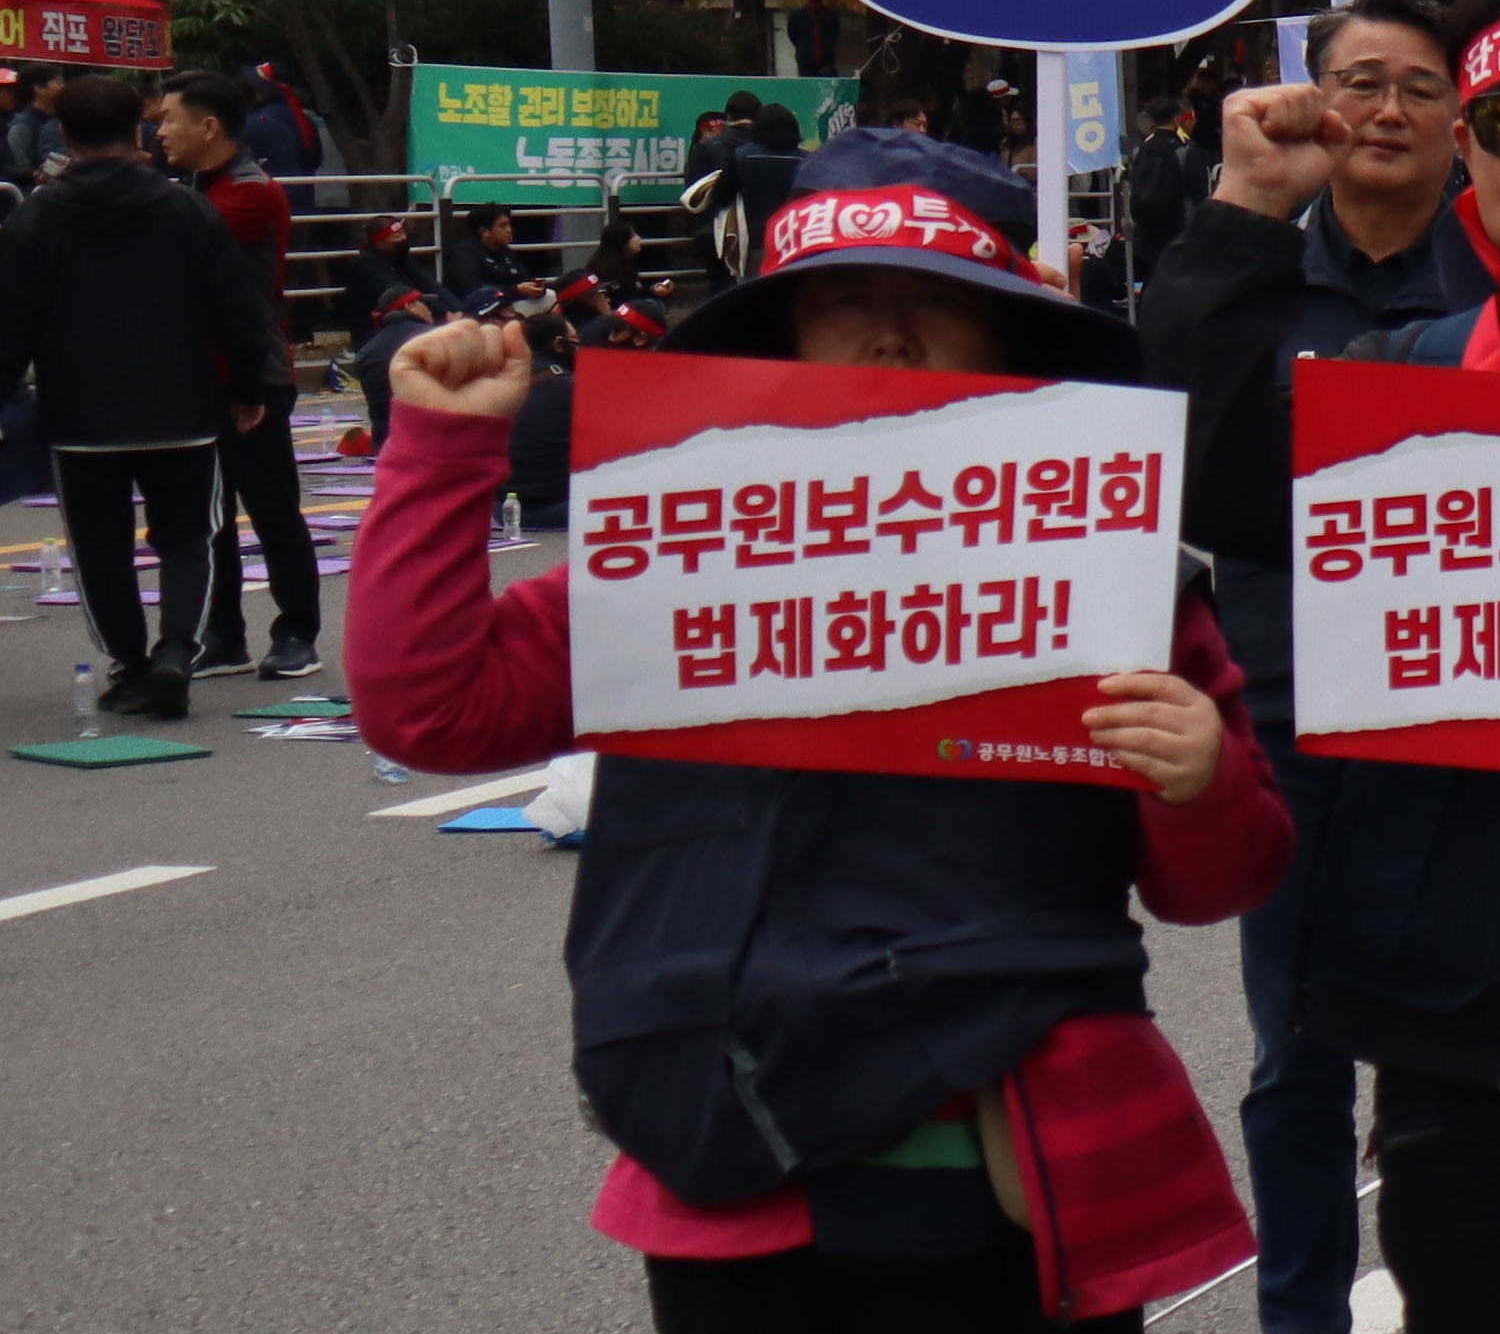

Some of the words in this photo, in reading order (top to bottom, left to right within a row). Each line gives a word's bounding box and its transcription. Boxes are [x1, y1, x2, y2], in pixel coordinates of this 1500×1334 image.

[42, 11, 90, 54] 쥐포
[438, 82, 513, 127] 노조할
[517, 86, 566, 128] 권리
[571, 87, 661, 129] 보장하고
[516, 136, 686, 188] 노동존중사회
[774, 198, 837, 265] 단결
[584, 452, 1162, 581] 공무원보수위원회
[674, 576, 1073, 690] 법제화하라!
[977, 743, 1123, 769] 공무원노동조합
